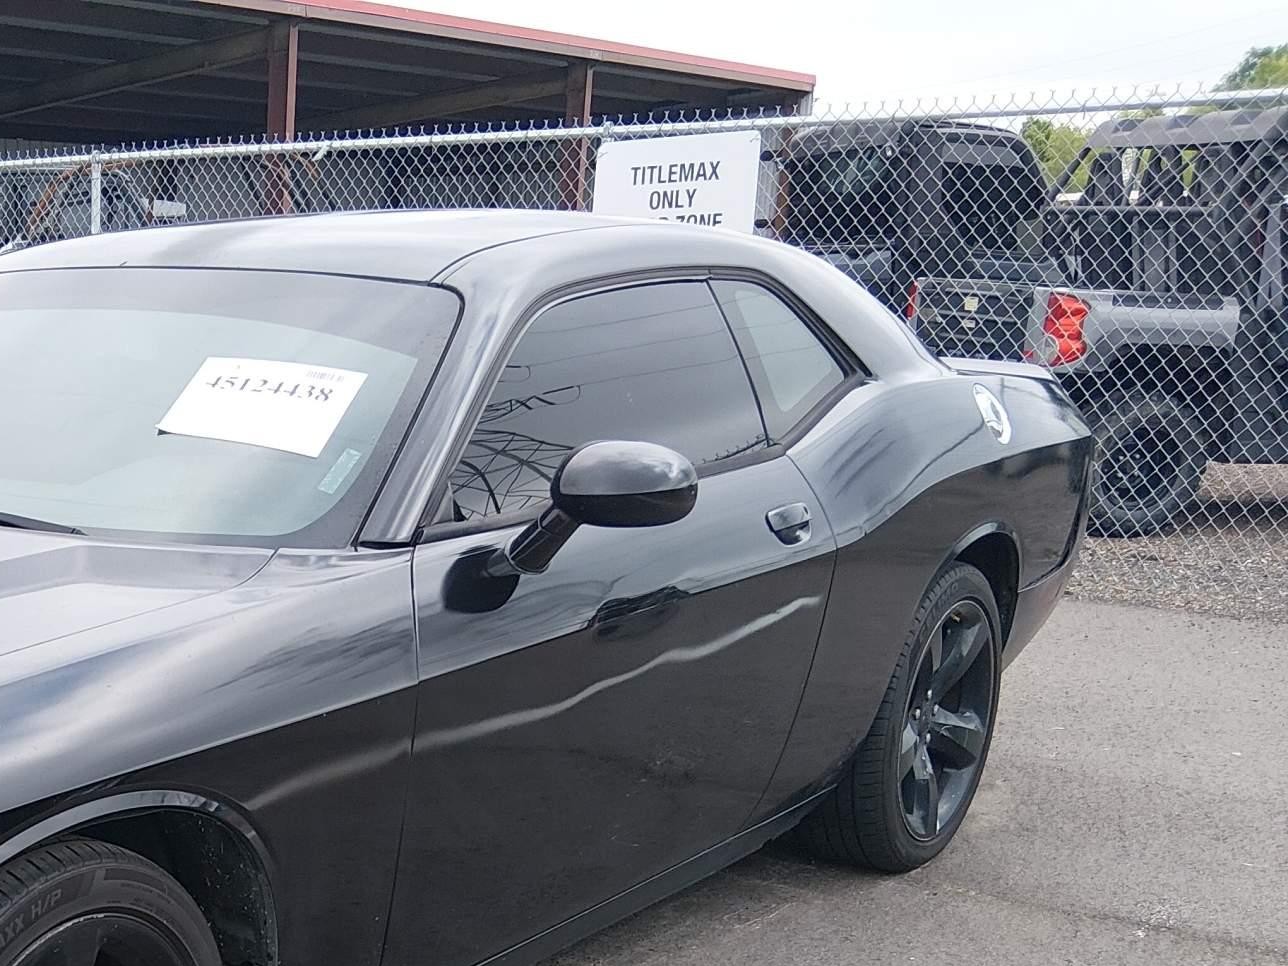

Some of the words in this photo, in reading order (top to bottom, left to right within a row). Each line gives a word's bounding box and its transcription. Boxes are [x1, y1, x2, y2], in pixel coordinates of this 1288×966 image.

[631, 161, 721, 186] TITLEMAX
[649, 188, 697, 210] ONLY
[206, 376, 333, 401] 45124438
[31, 889, 62, 920] H/P
